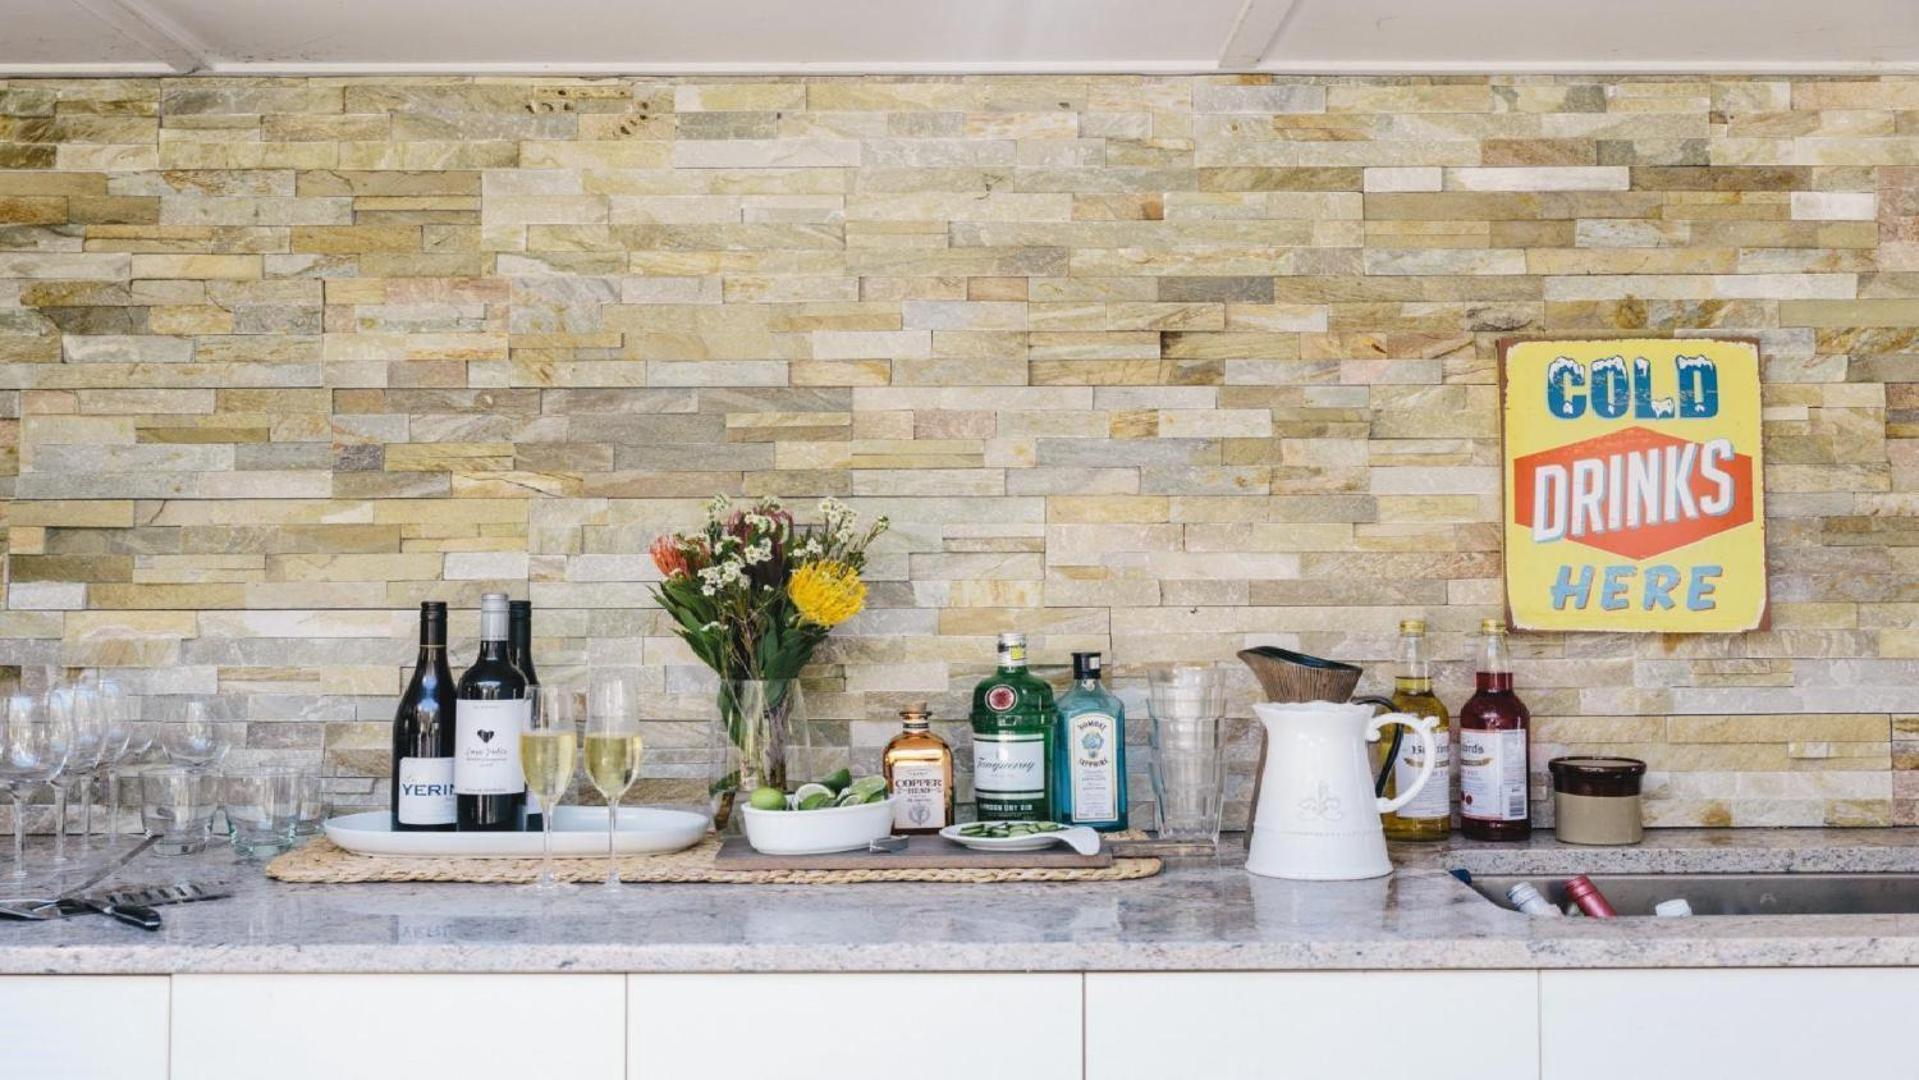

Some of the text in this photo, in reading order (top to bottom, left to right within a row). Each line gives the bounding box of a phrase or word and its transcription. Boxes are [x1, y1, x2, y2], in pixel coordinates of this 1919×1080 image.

[1547, 355, 1719, 419] COLD
[1532, 438, 1735, 544] DRINKS
[1550, 565, 1724, 611] HERE
